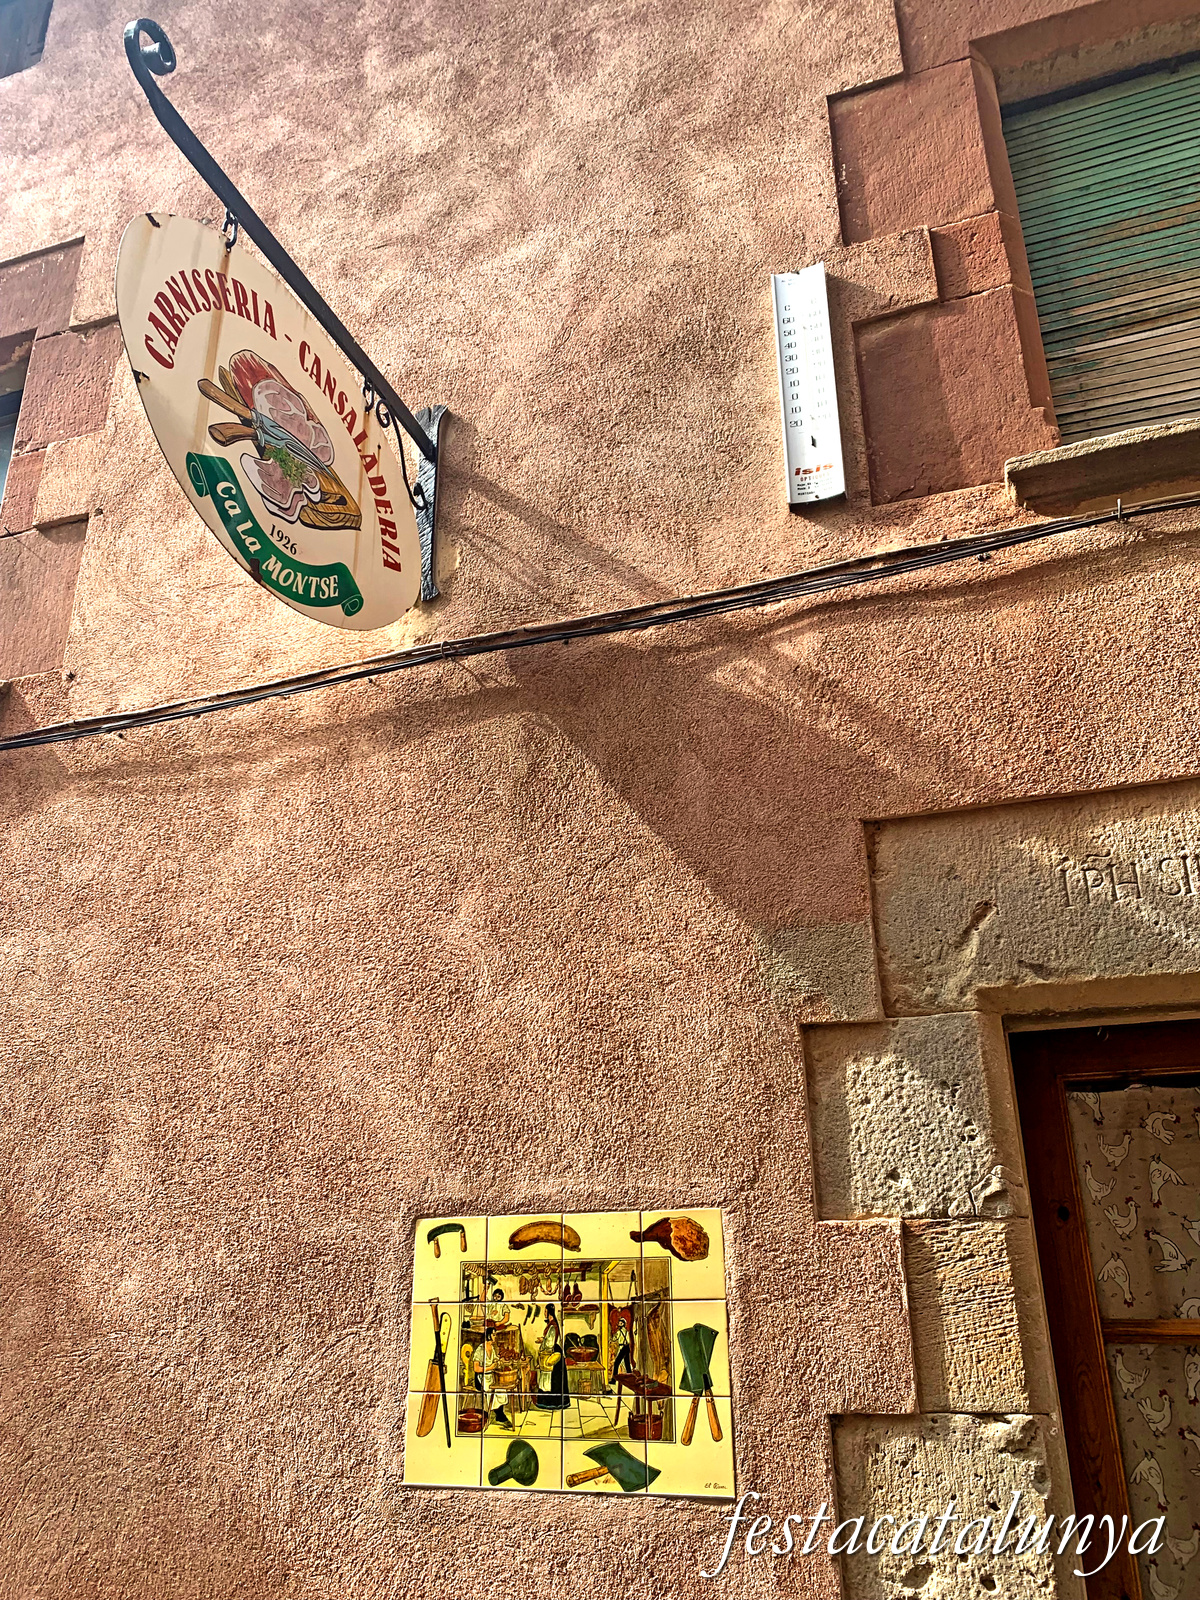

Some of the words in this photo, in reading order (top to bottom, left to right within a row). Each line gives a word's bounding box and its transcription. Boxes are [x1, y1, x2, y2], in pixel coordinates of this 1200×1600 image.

[782, 316, 795, 324] 60
[783, 328, 796, 337] 50
[784, 341, 797, 349] 40
[785, 353, 798, 362] 30
[785, 366, 799, 375] 20
[788, 379, 800, 388] 10
[791, 392, 799, 401] 0
[790, 405, 801, 414] 10
[145, 269, 278, 369] CARNISSERIA
[299, 340, 402, 573] CANSALADERIA
[789, 418, 803, 428] 20
[215, 480, 242, 519] Ca
[236, 517, 262, 555] La
[261, 554, 339, 599] MONTSE
[268, 524, 298, 556] 1926
